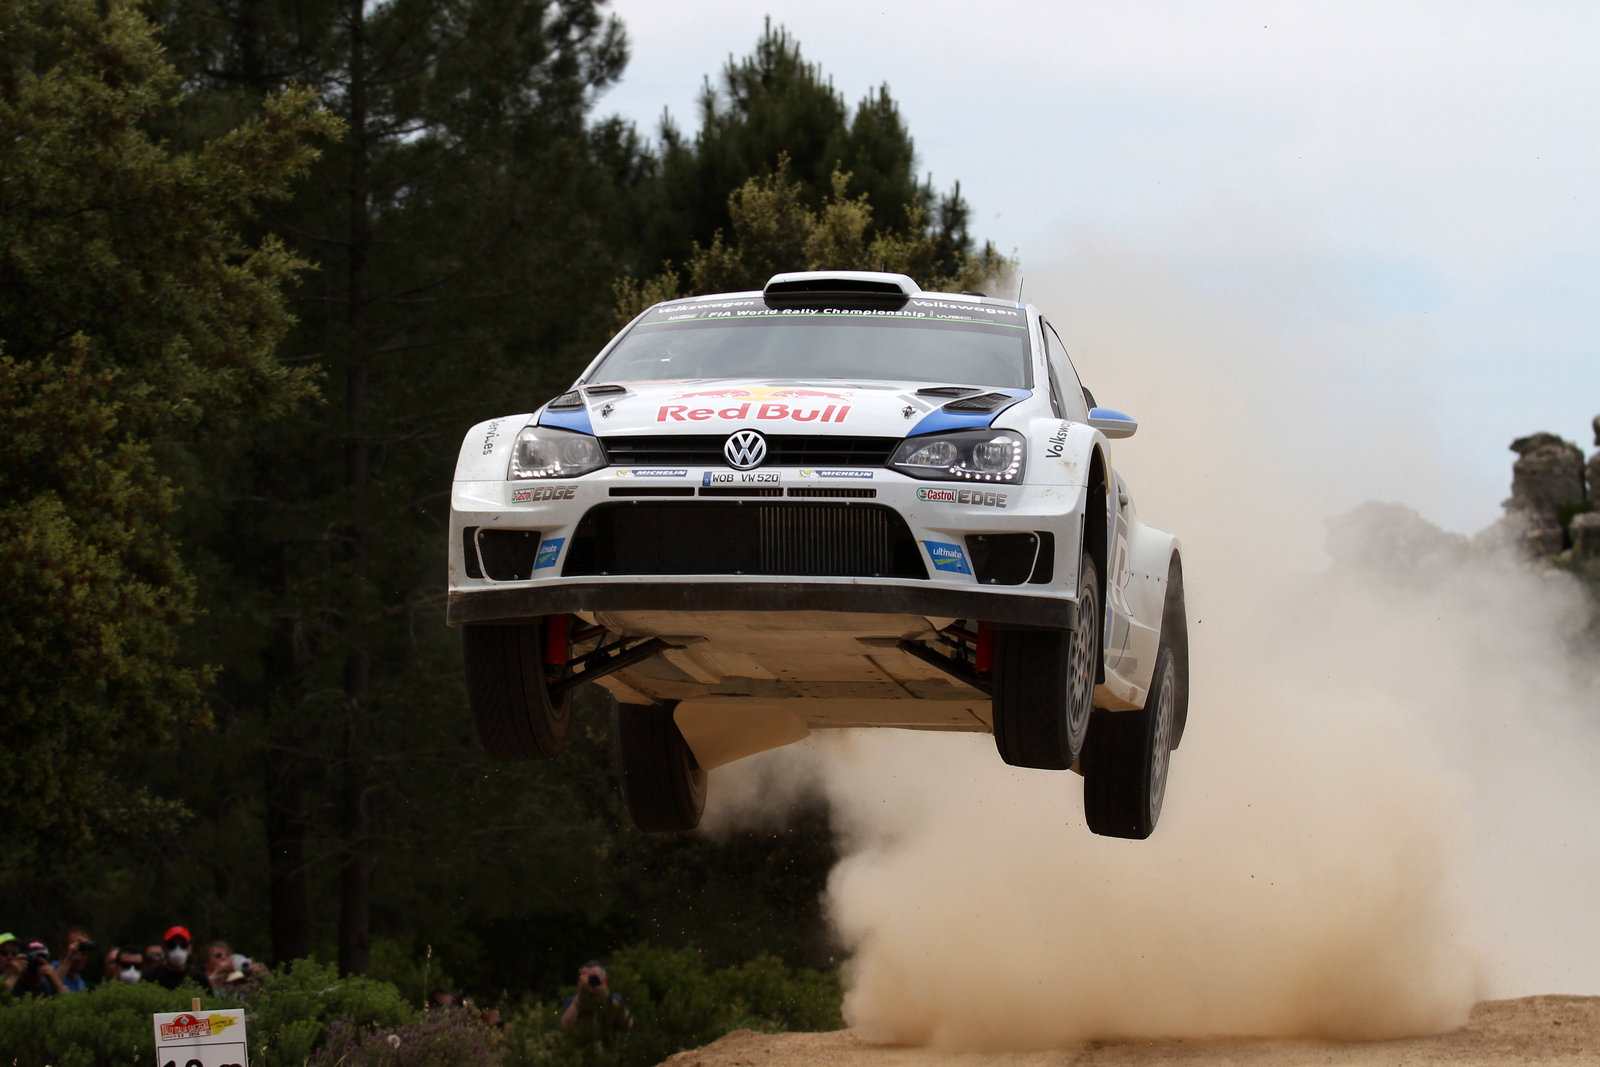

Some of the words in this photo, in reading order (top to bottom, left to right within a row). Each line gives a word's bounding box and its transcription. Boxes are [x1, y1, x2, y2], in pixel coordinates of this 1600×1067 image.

[658, 301, 754, 314] Volkswagen
[782, 308, 819, 316] Rally
[823, 308, 925, 318] Championship
[912, 300, 1018, 317] Volkswagen
[657, 403, 760, 422] Red
[766, 404, 851, 423] Bull
[713, 474, 734, 483] WOB
[757, 474, 779, 483] 520
[532, 486, 578, 501] EDGE
[927, 489, 955, 501] Castrol
[958, 490, 1008, 509] EDGE
[933, 547, 962, 559] ultimate
